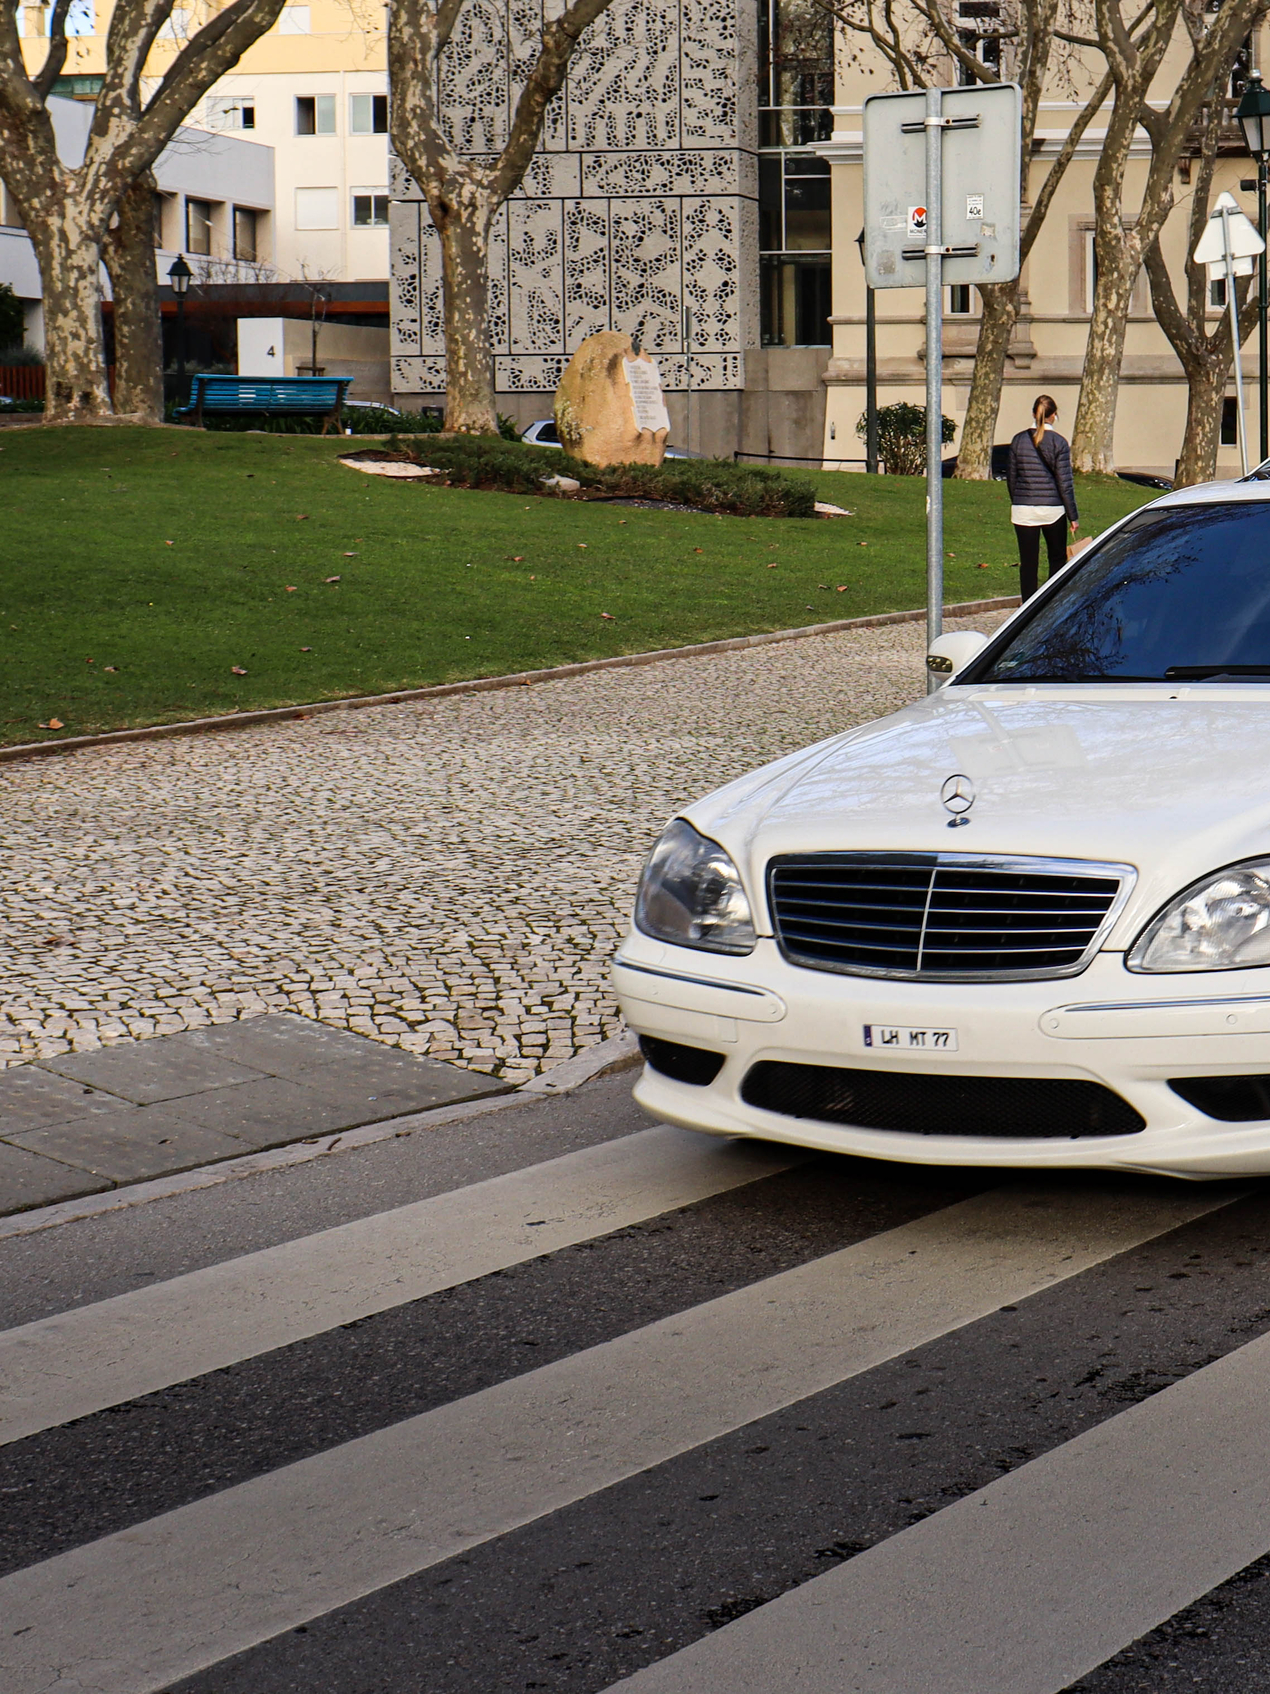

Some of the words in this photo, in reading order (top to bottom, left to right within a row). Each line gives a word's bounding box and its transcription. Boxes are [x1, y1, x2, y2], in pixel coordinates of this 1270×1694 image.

[267, 345, 276, 357] 4
[881, 1029, 899, 1045] LH
[932, 1032, 950, 1047] 77
